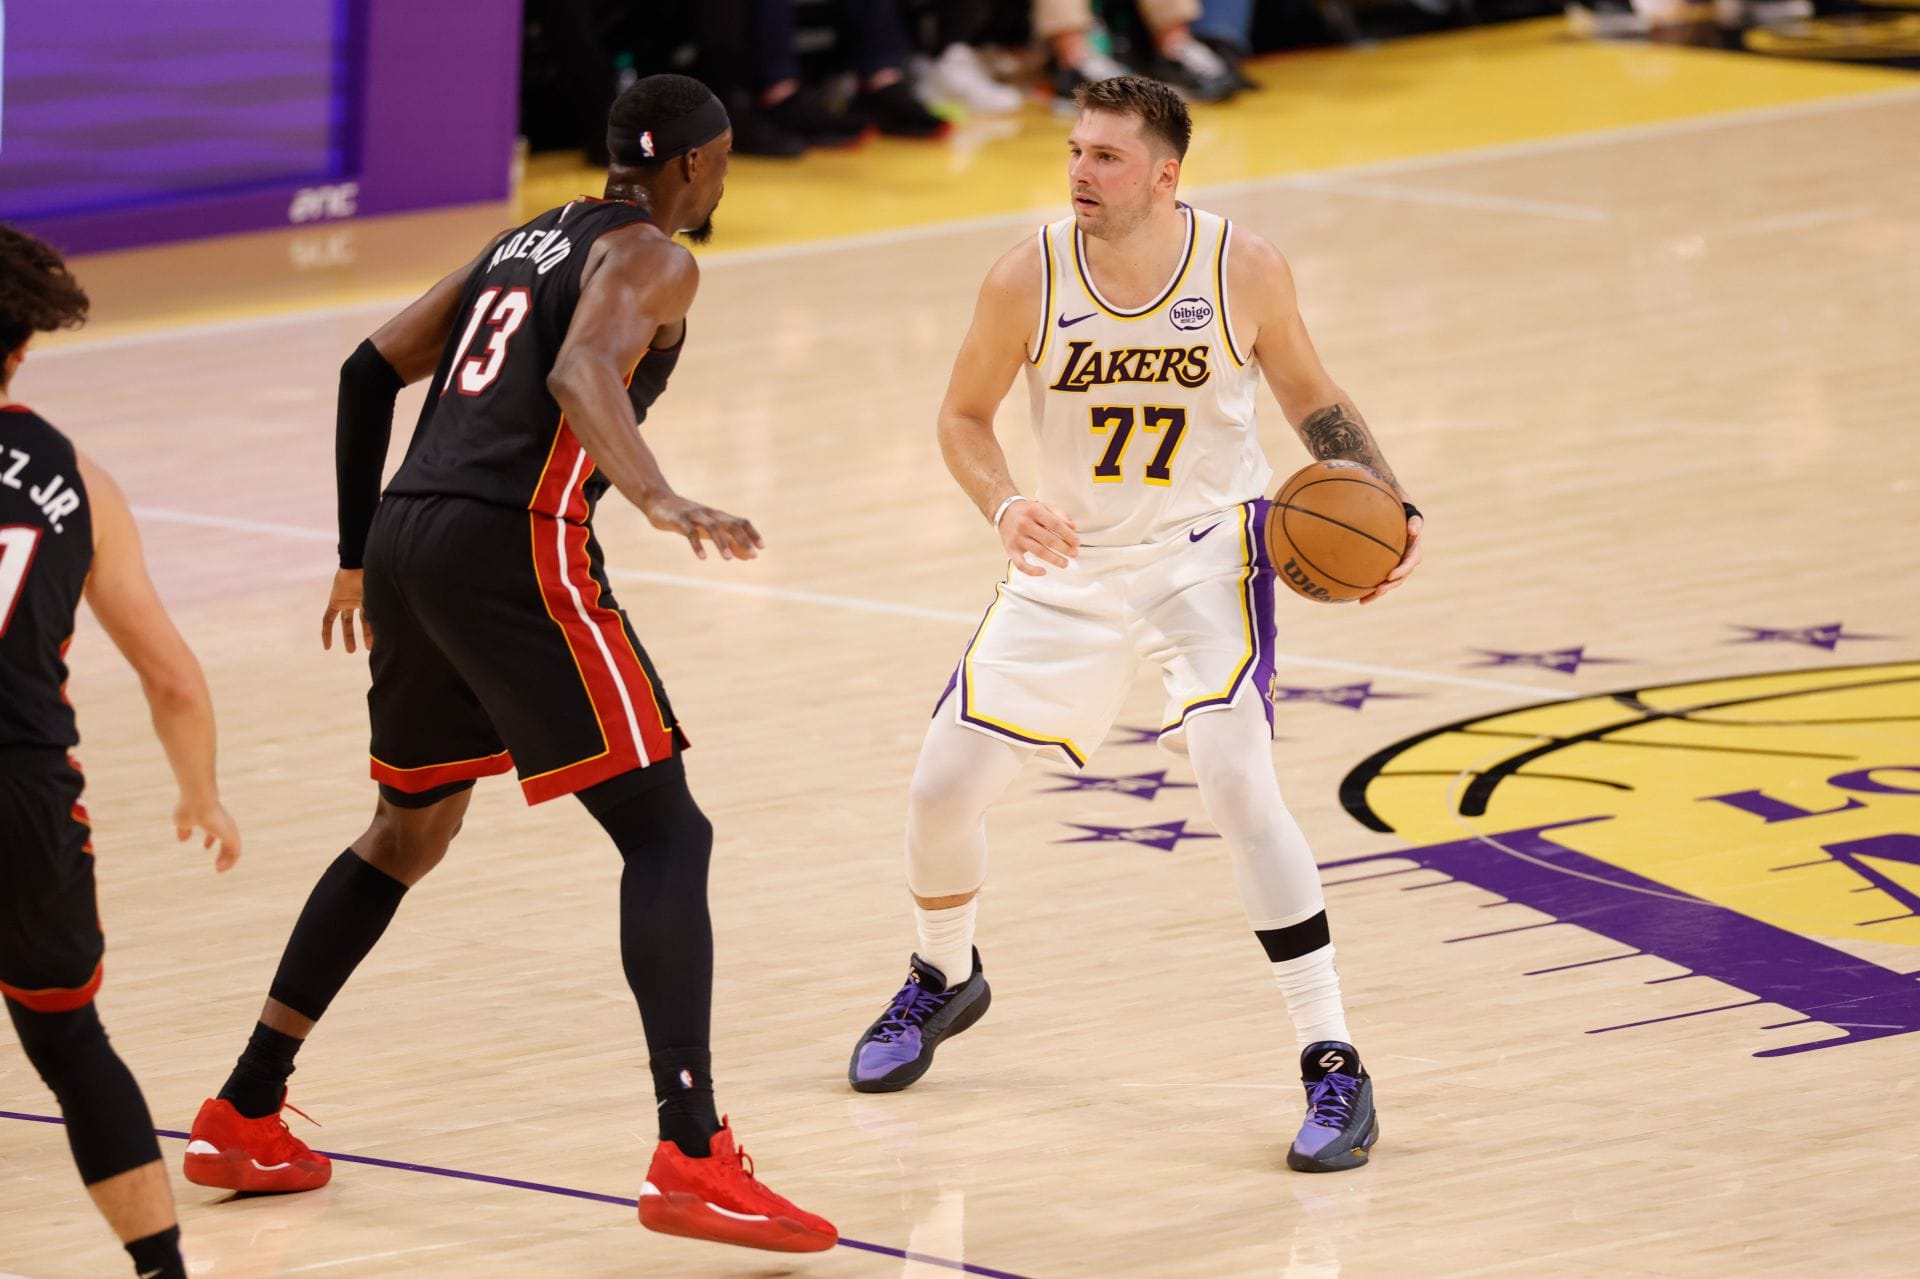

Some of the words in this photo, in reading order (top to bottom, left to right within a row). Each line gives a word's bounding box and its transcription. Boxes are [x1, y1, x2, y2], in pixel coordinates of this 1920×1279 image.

[440, 286, 532, 397] 13
[1173, 306, 1211, 320] bibigo
[1049, 340, 1213, 393] LAKERS
[1088, 404, 1189, 487] 77
[29, 474, 80, 535] JR.
